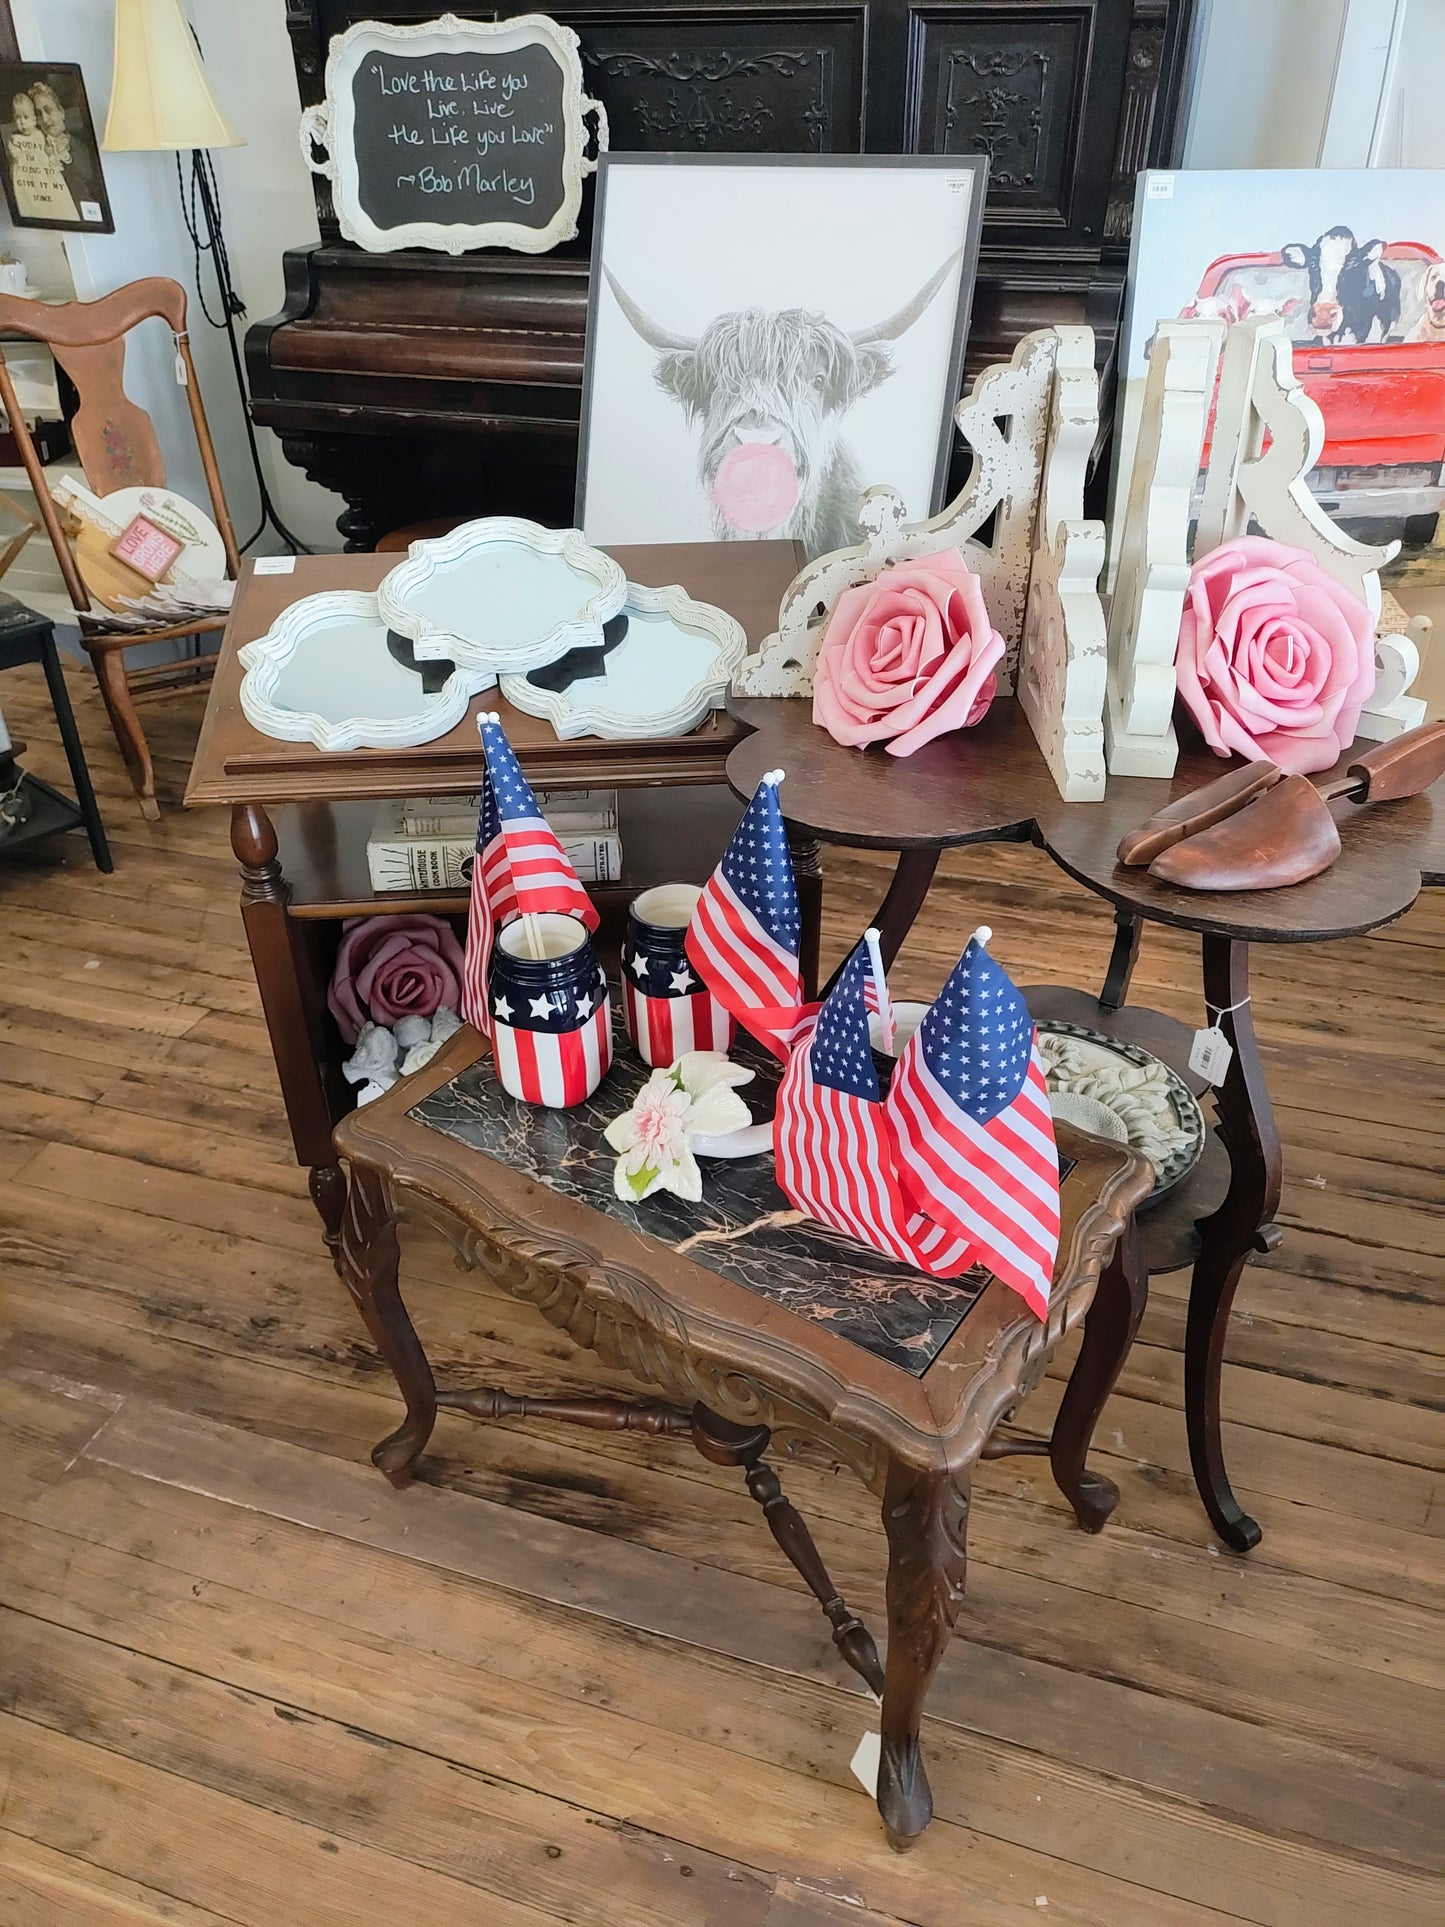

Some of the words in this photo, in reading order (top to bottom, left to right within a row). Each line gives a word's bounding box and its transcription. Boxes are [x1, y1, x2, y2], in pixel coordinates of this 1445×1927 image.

[421, 69, 458, 92] the
[460, 69, 497, 92] Life
[502, 73, 528, 100] you
[473, 100, 515, 118] Live
[431, 122, 470, 146] Life
[476, 130, 505, 156] you
[16, 179, 36, 188] GIVE
[40, 181, 48, 189] IT
[52, 182, 65, 191] MY
[44, 167, 56, 176] TO
[457, 163, 535, 205] Marley
[120, 525, 148, 555] LOVE
[131, 531, 164, 567] GROWS
[147, 543, 176, 574] HERE
[430, 850, 439, 870] BOOK
[431, 870, 441, 887] COOK
